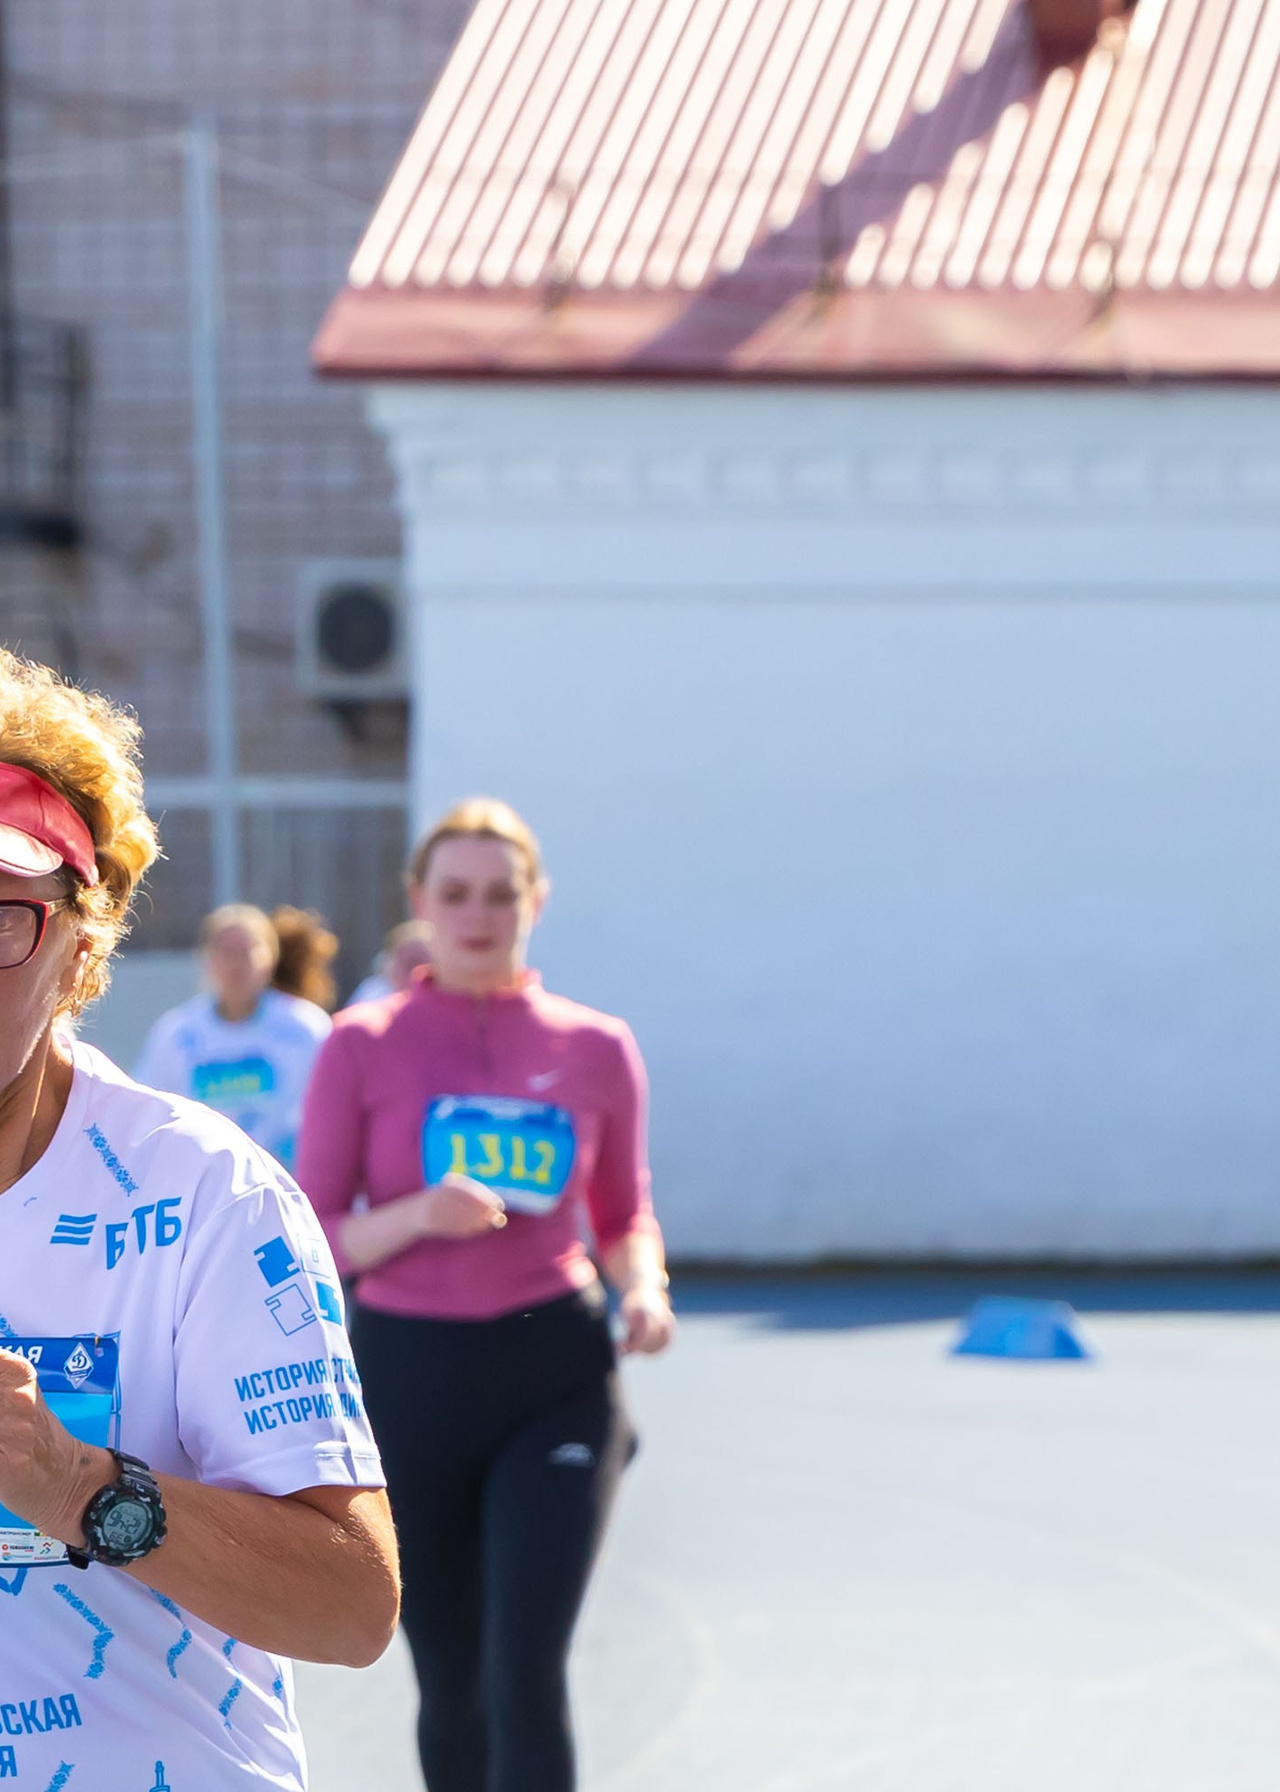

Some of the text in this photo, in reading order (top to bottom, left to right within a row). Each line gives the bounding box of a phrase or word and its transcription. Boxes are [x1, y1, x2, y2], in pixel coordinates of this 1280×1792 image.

[449, 1133, 556, 1185] 1312
[234, 1358, 327, 1402] ИСТОРИЯ
[244, 1393, 336, 1435] ИСТОРИЯ
